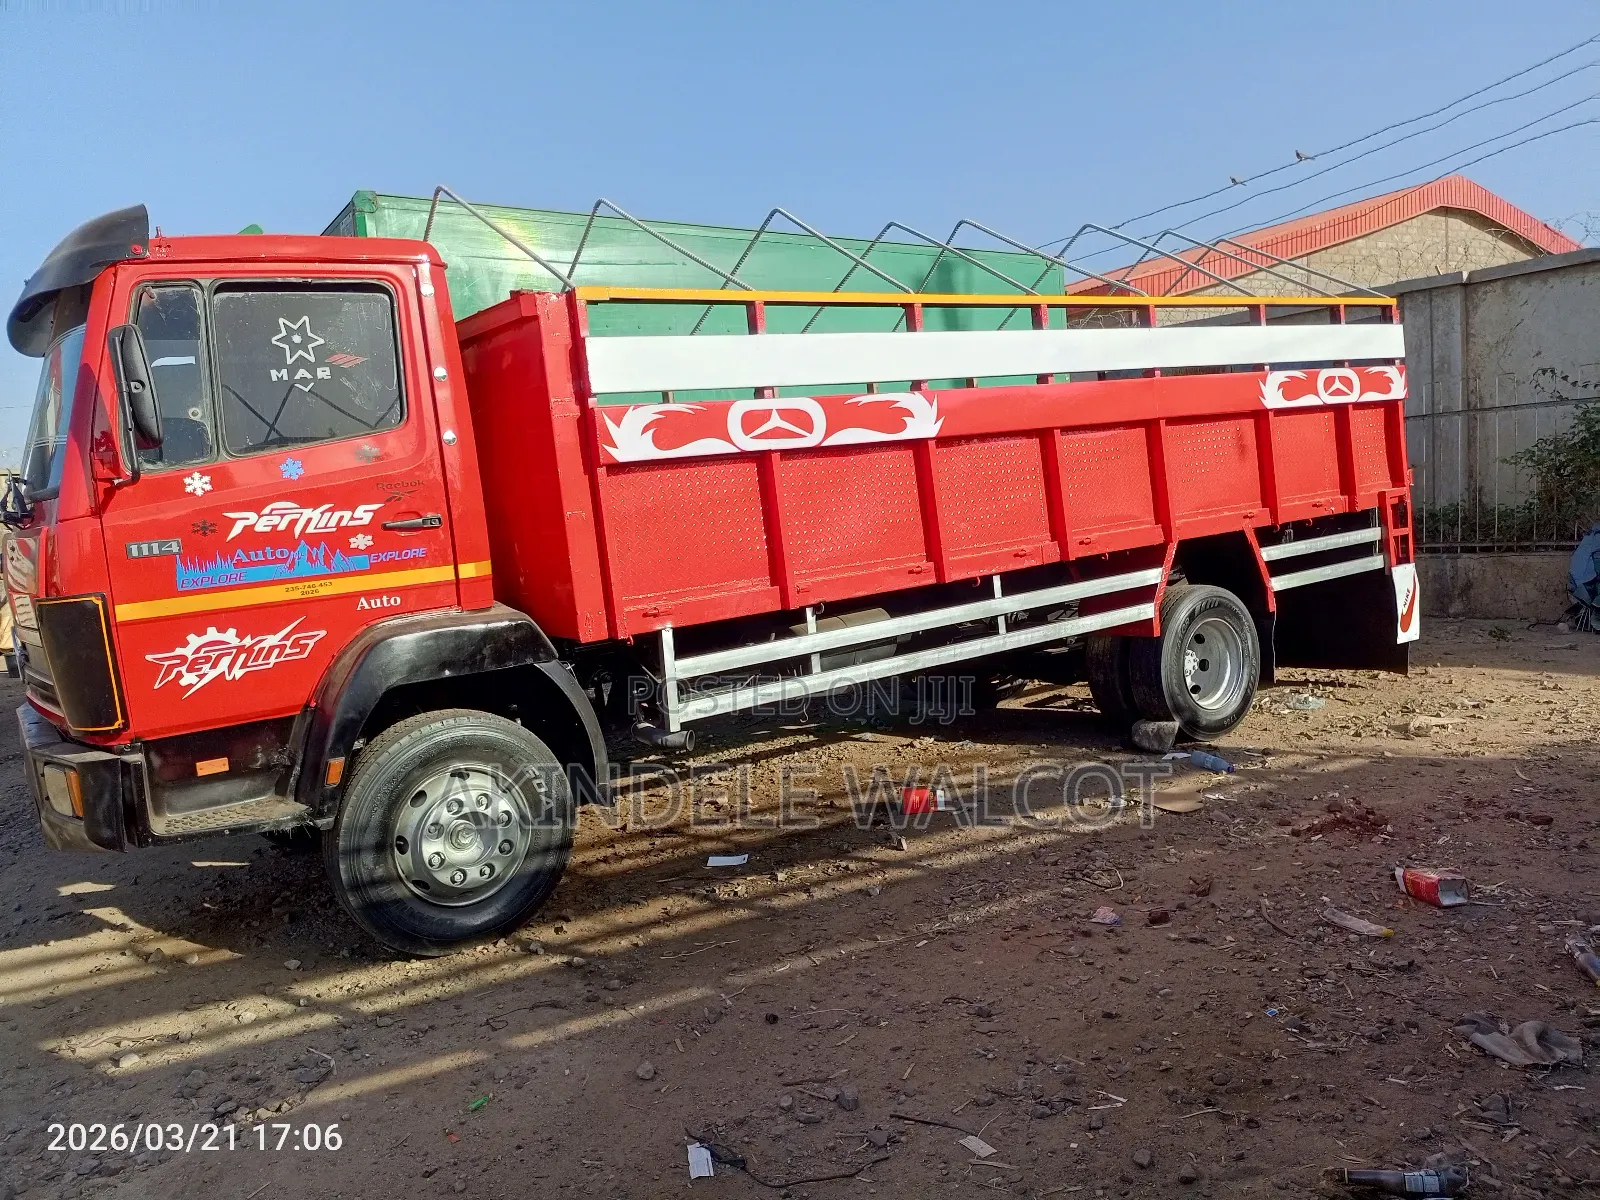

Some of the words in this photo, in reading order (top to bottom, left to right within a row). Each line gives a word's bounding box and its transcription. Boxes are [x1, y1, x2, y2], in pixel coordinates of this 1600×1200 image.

[375, 479, 426, 491] Reebok
[129, 540, 180, 557] 1114
[232, 547, 289, 564] Auto
[369, 547, 428, 564] EXPLORE
[180, 571, 248, 590] EXPLORE
[356, 594, 402, 611] Auto
